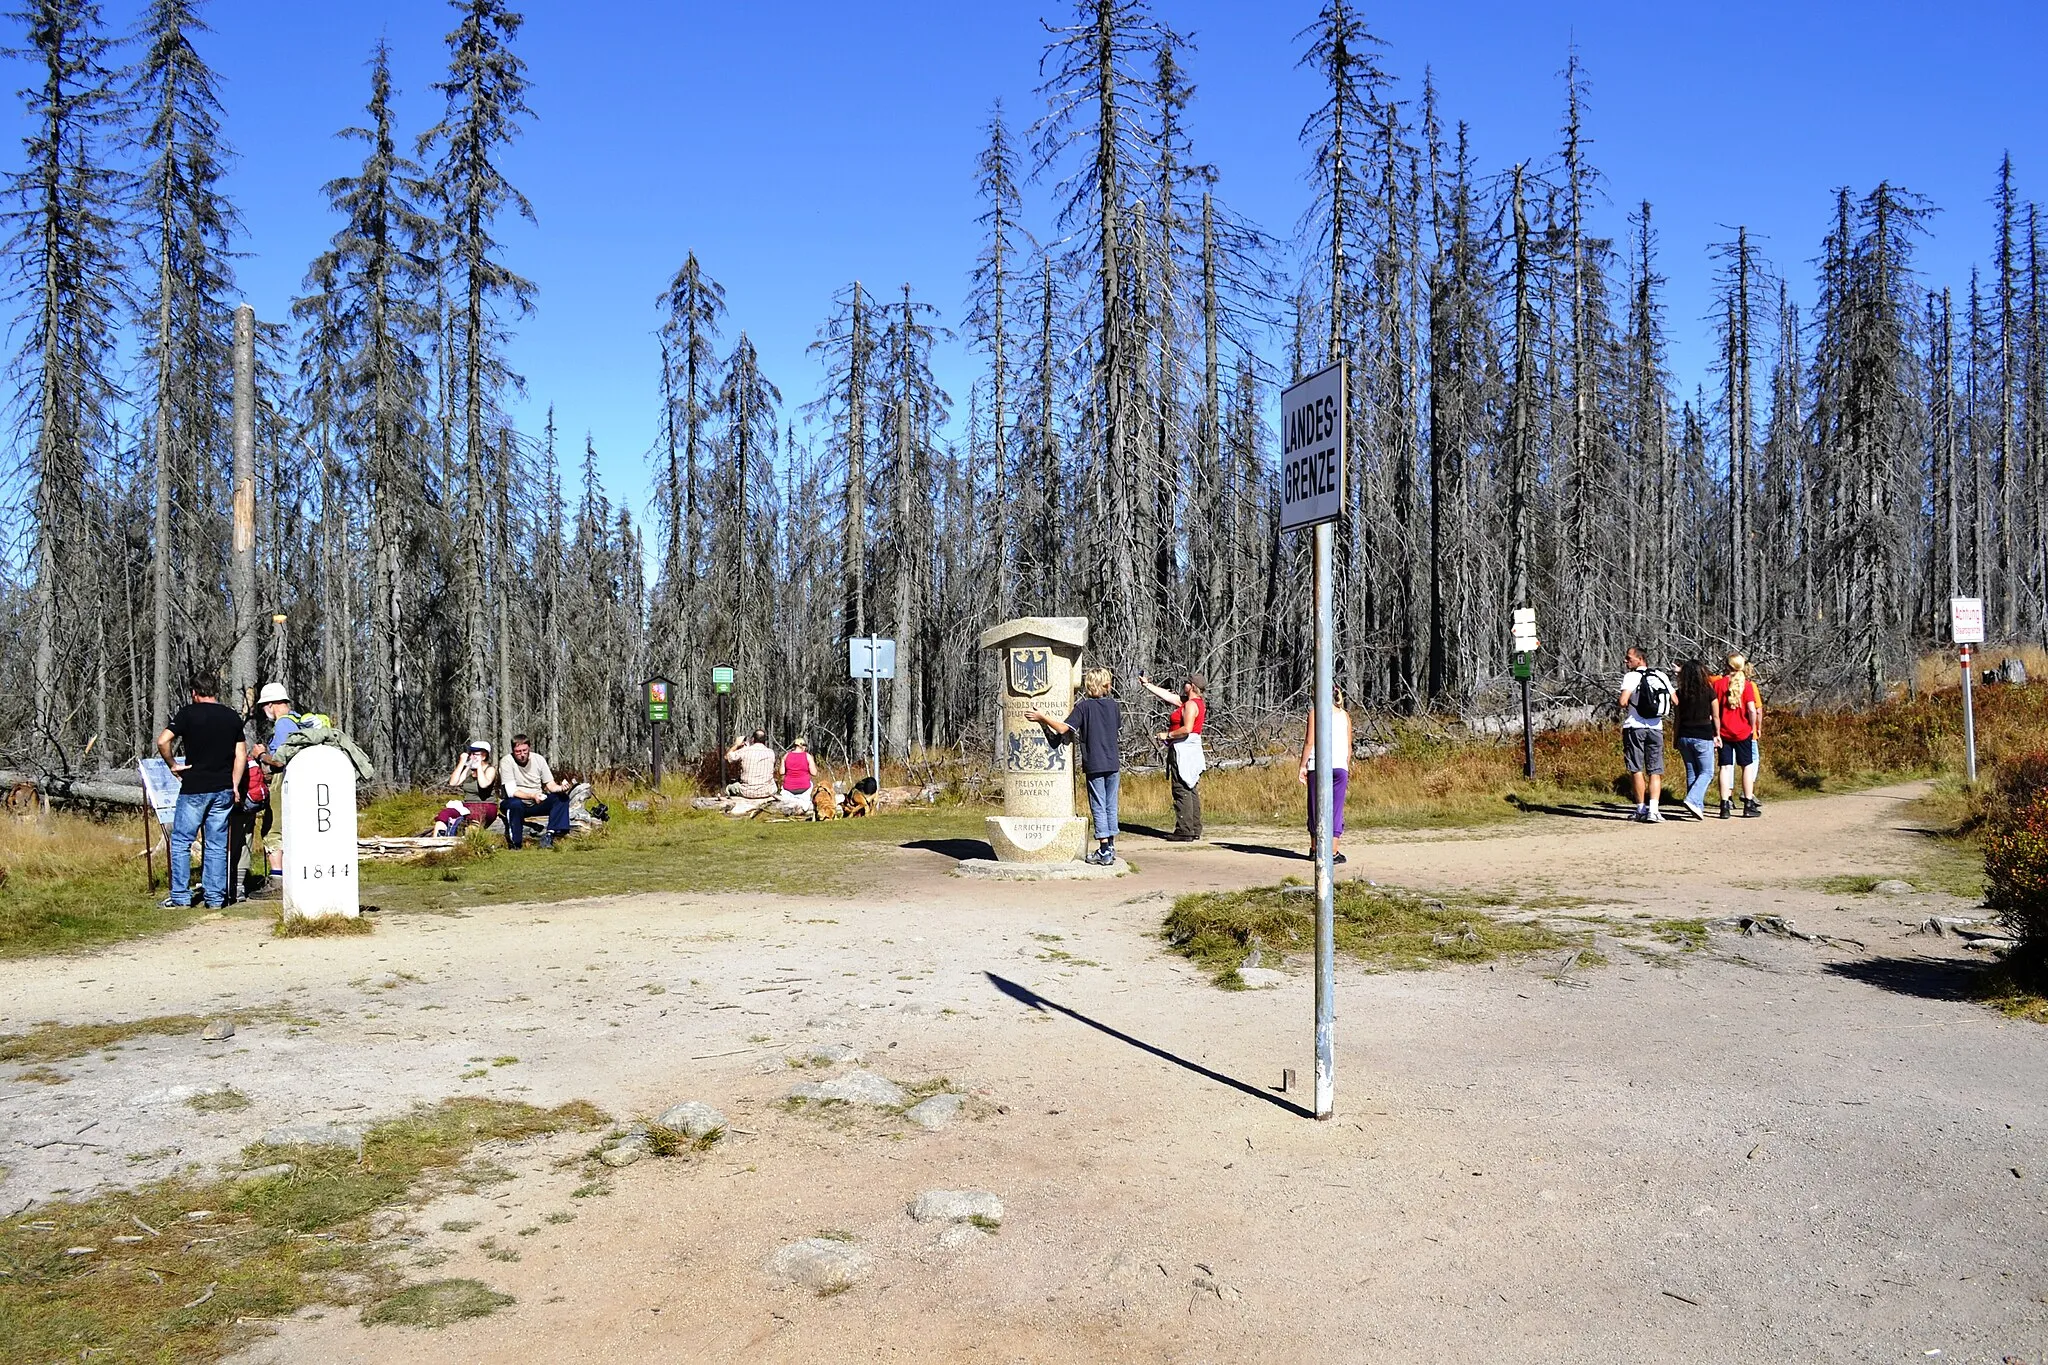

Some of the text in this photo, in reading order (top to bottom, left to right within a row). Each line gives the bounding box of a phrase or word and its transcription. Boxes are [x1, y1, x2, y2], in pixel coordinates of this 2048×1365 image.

[1284, 395, 1337, 455] LANDES-
[1284, 447, 1336, 505] GRENZE
[1015, 780, 1055, 788] FREISTAAT
[1019, 788, 1050, 796] BAYERN
[317, 783, 330, 807] D
[317, 807, 332, 832] B
[1014, 824, 1056, 832] ERRICHTET
[303, 864, 351, 880] 1844
